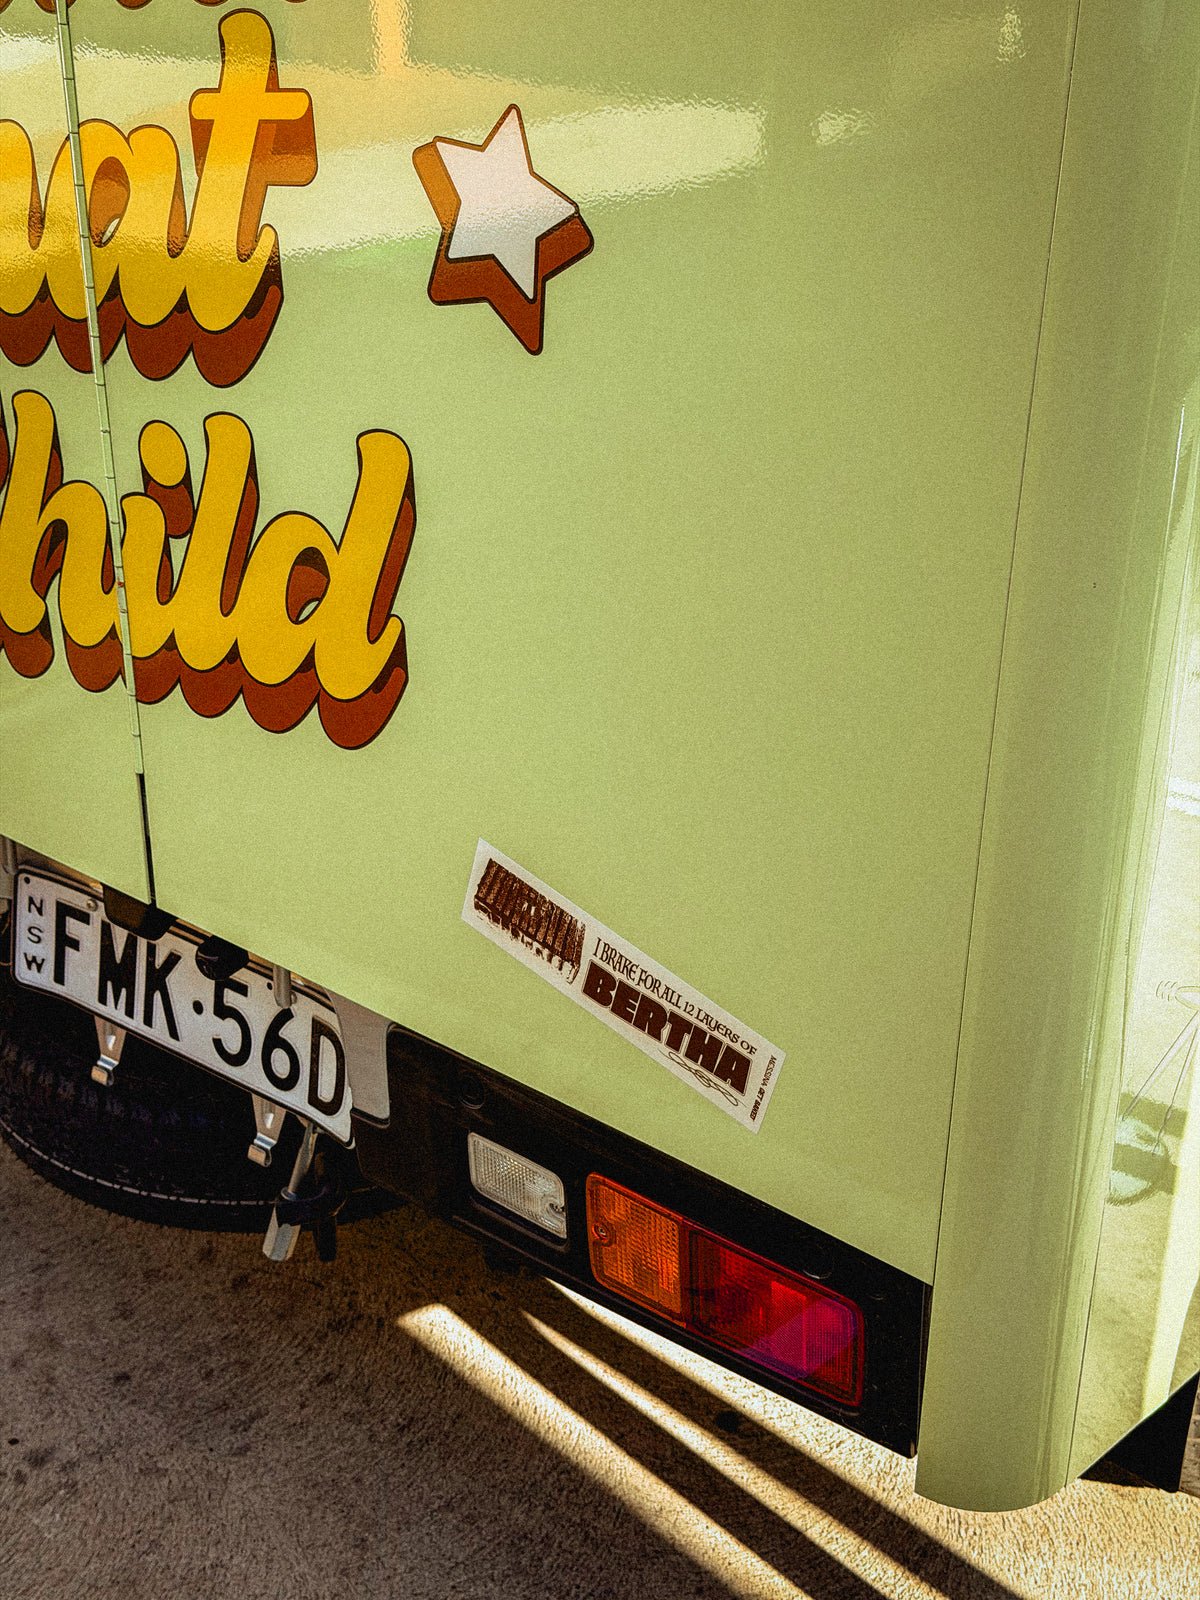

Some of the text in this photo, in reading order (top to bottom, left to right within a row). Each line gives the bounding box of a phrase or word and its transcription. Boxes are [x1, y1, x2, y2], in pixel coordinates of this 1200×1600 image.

[0, 388, 416, 749] hild
[582, 959, 753, 1096] BERTHA
[593, 937, 757, 1056] I BRAKE FOR ALL 12 LAYERS OF
[749, 1100, 761, 1121] BAKED
[761, 1054, 777, 1087] MESSINA
